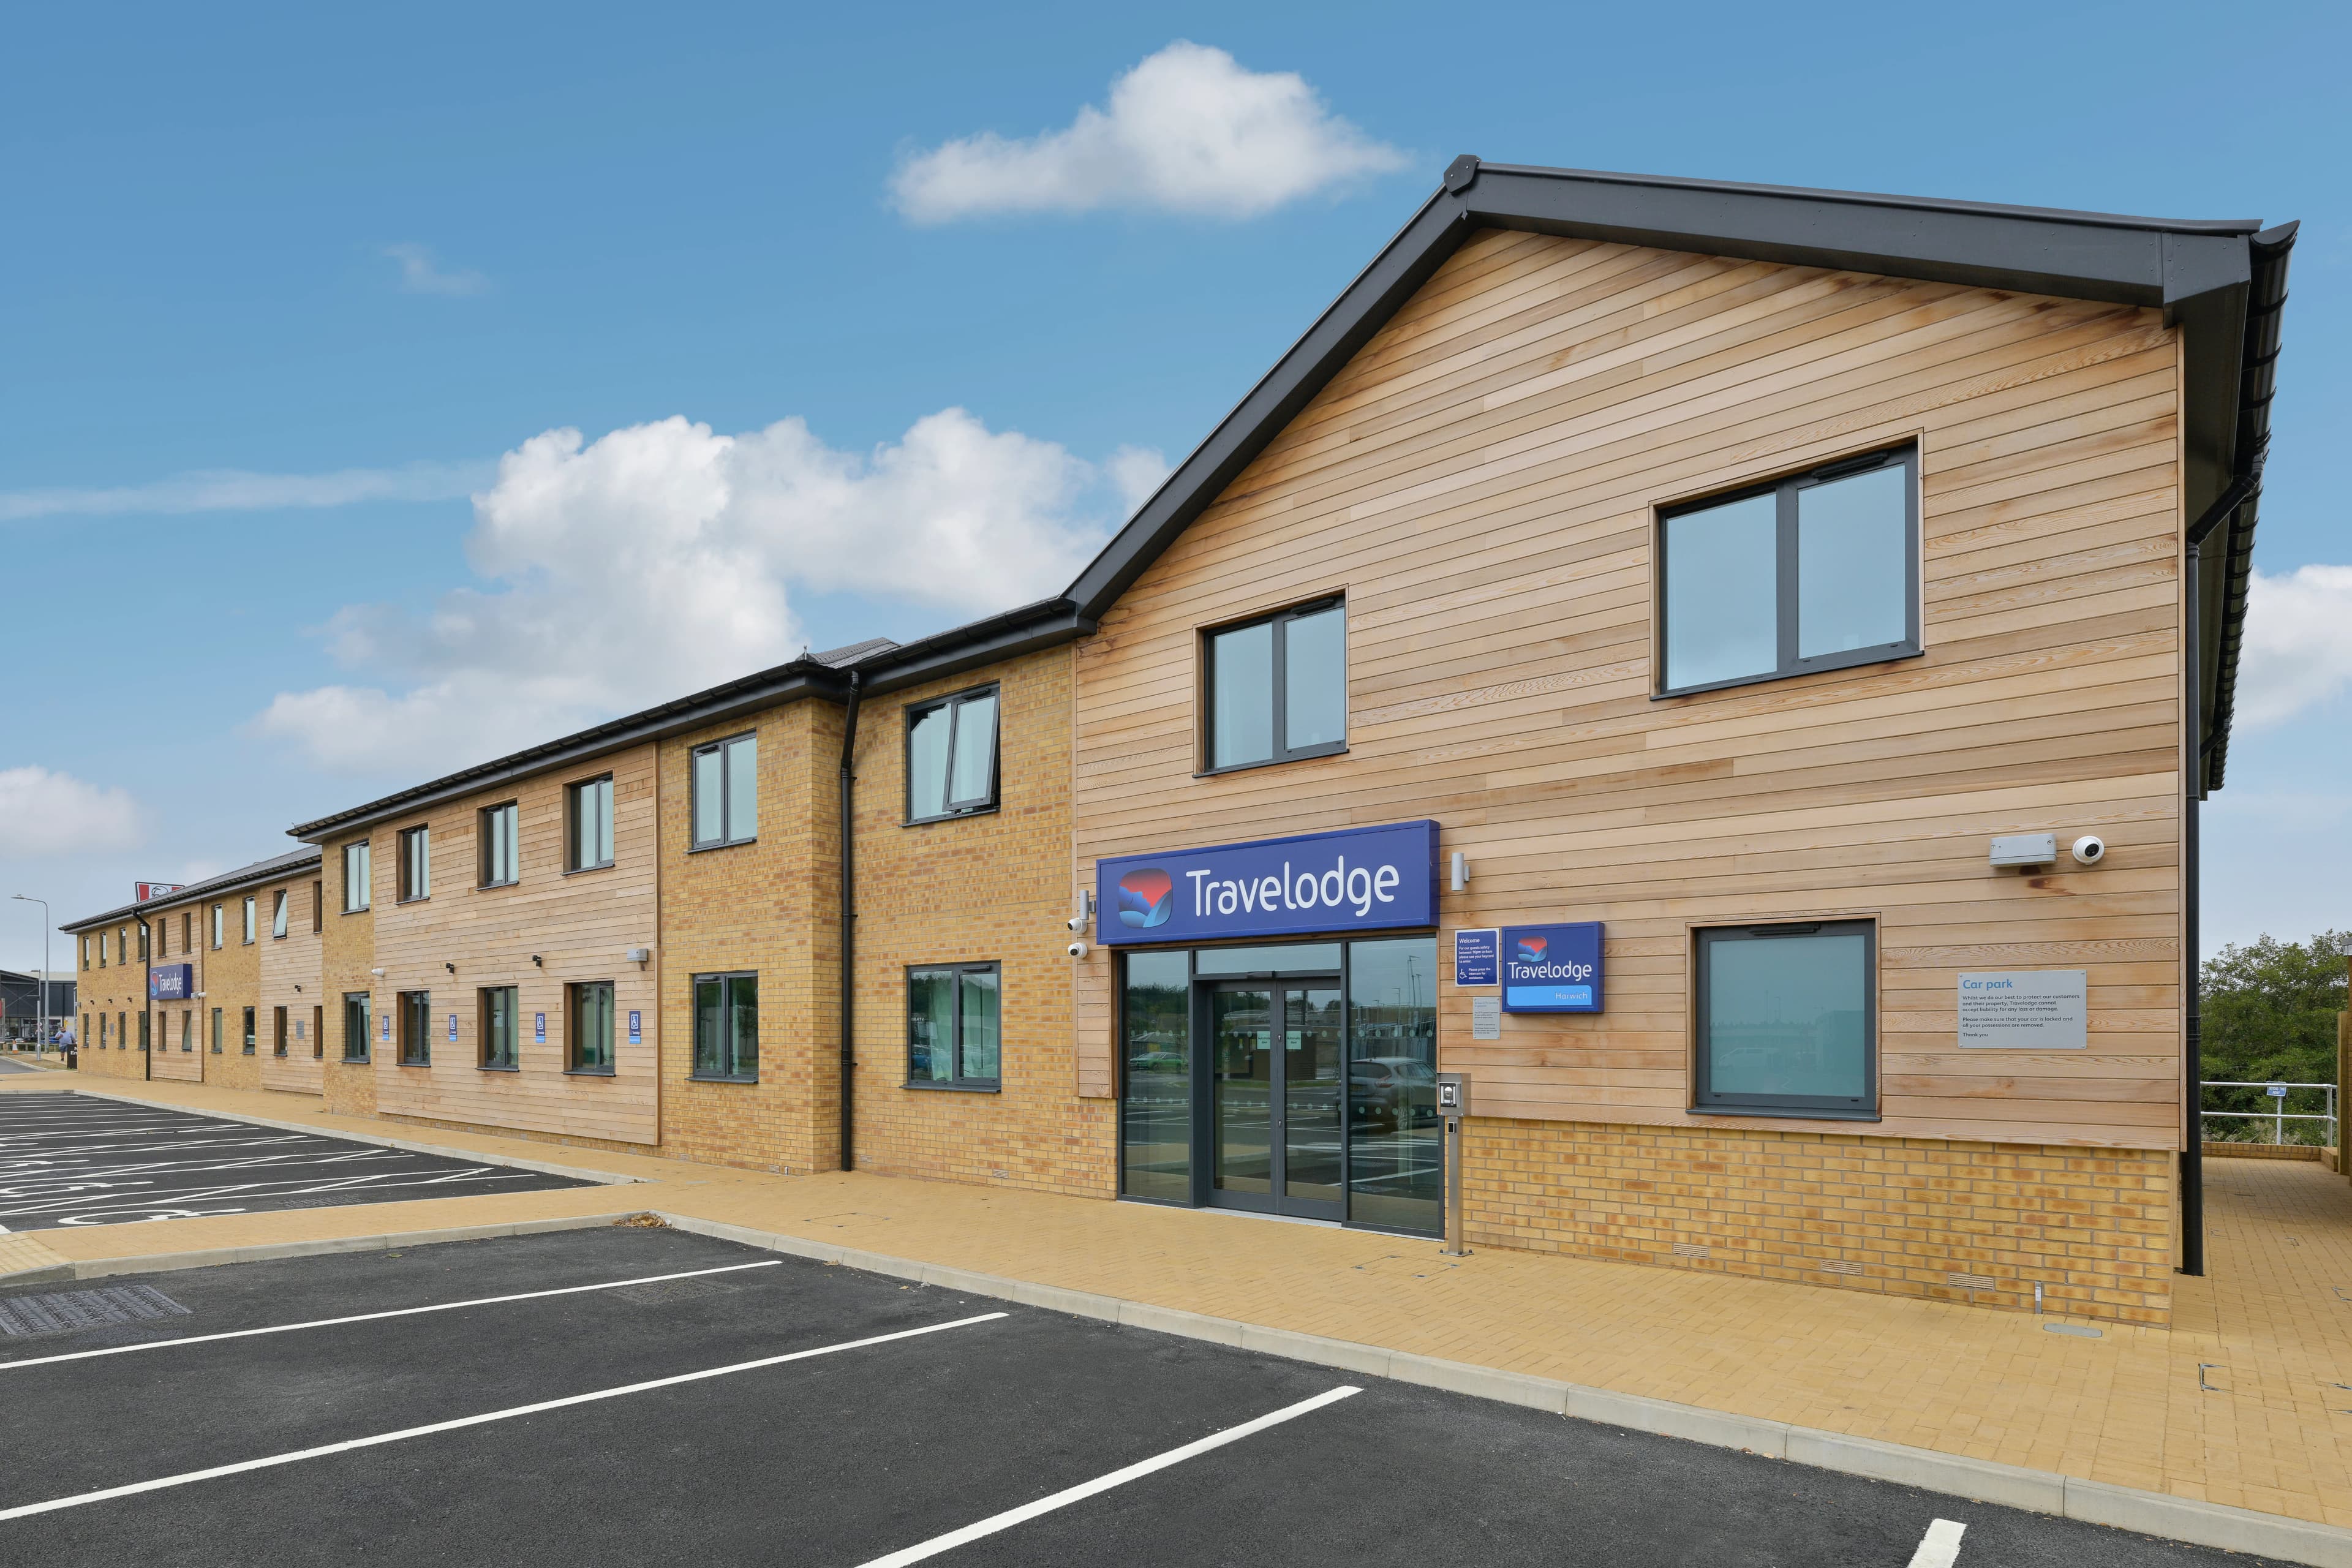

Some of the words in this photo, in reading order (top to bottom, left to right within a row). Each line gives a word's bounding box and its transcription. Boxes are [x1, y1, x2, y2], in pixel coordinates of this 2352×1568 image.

[1186, 855, 1400, 917] Travelodge
[1507, 960, 1592, 982] Travelodge
[159, 971, 182, 995] Travelodge
[1963, 980, 1983, 989] Car
[1986, 979, 2013, 990] park
